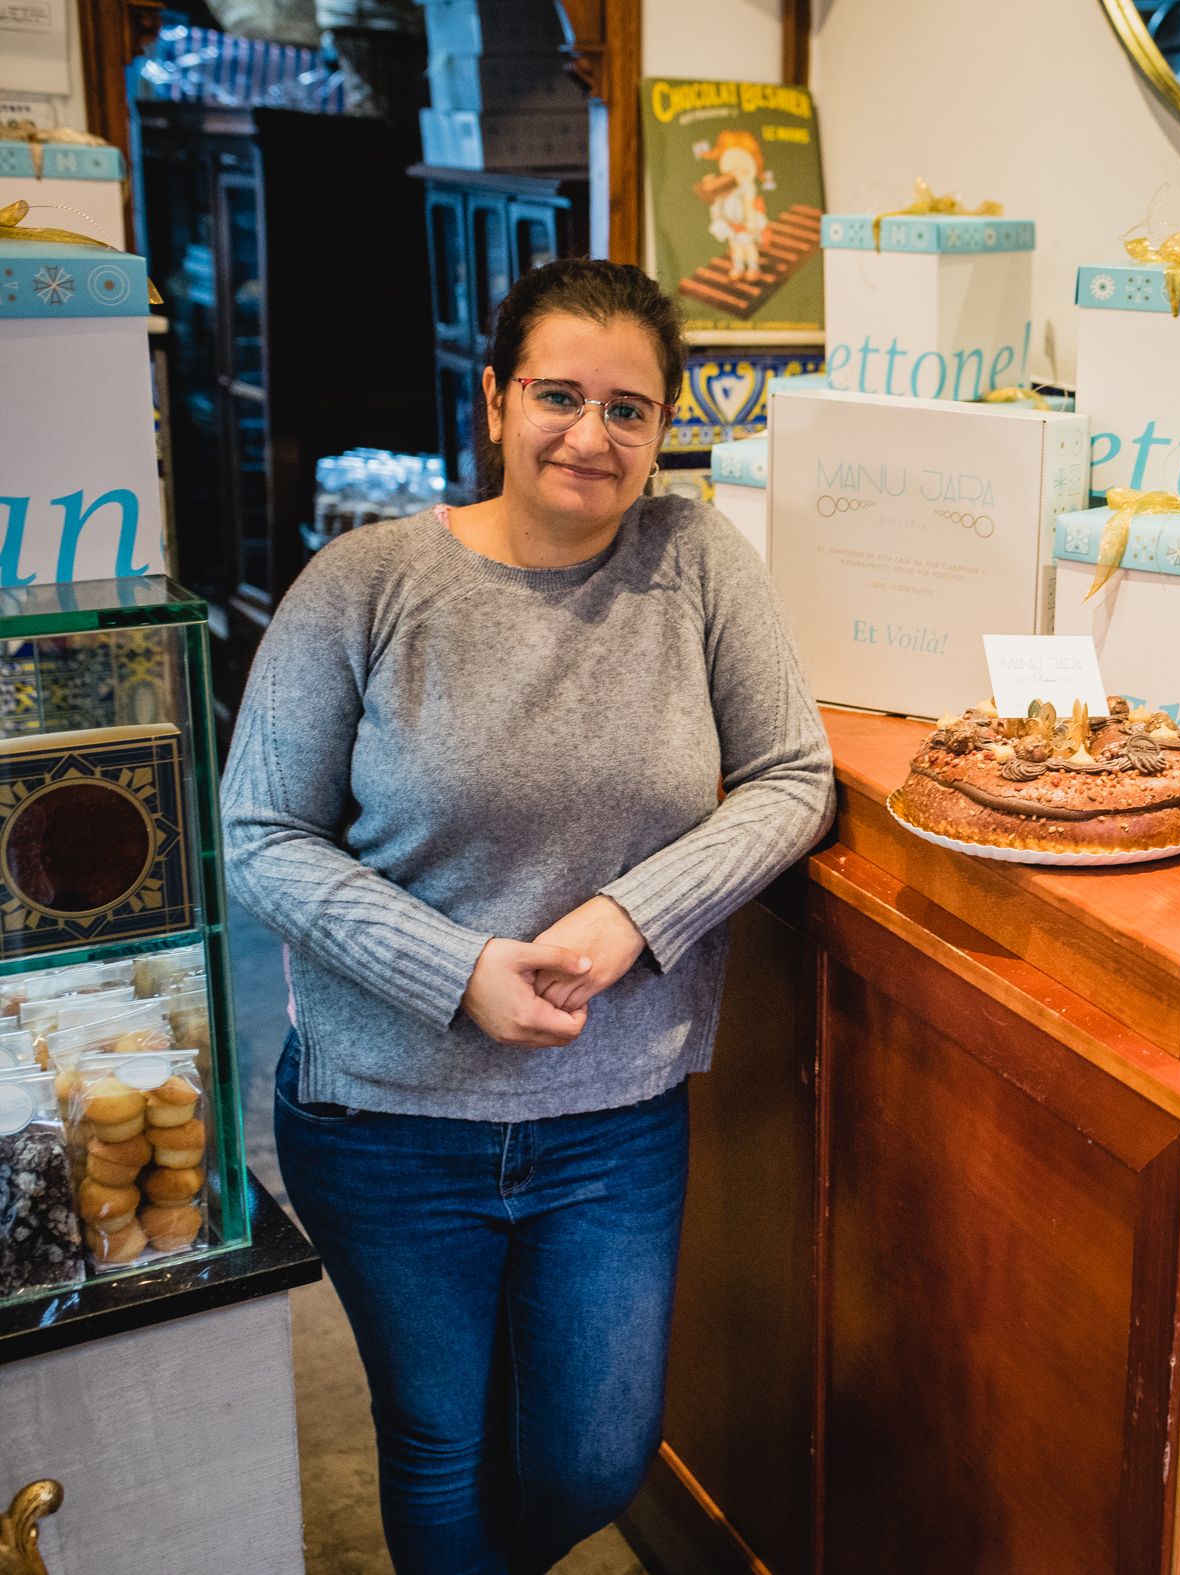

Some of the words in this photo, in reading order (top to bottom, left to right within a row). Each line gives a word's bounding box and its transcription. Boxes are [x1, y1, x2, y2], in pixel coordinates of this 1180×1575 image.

[816, 459, 907, 497] MANU
[919, 469, 996, 508] JARA
[853, 619, 877, 644] Et
[886, 623, 949, 655] Voilà!
